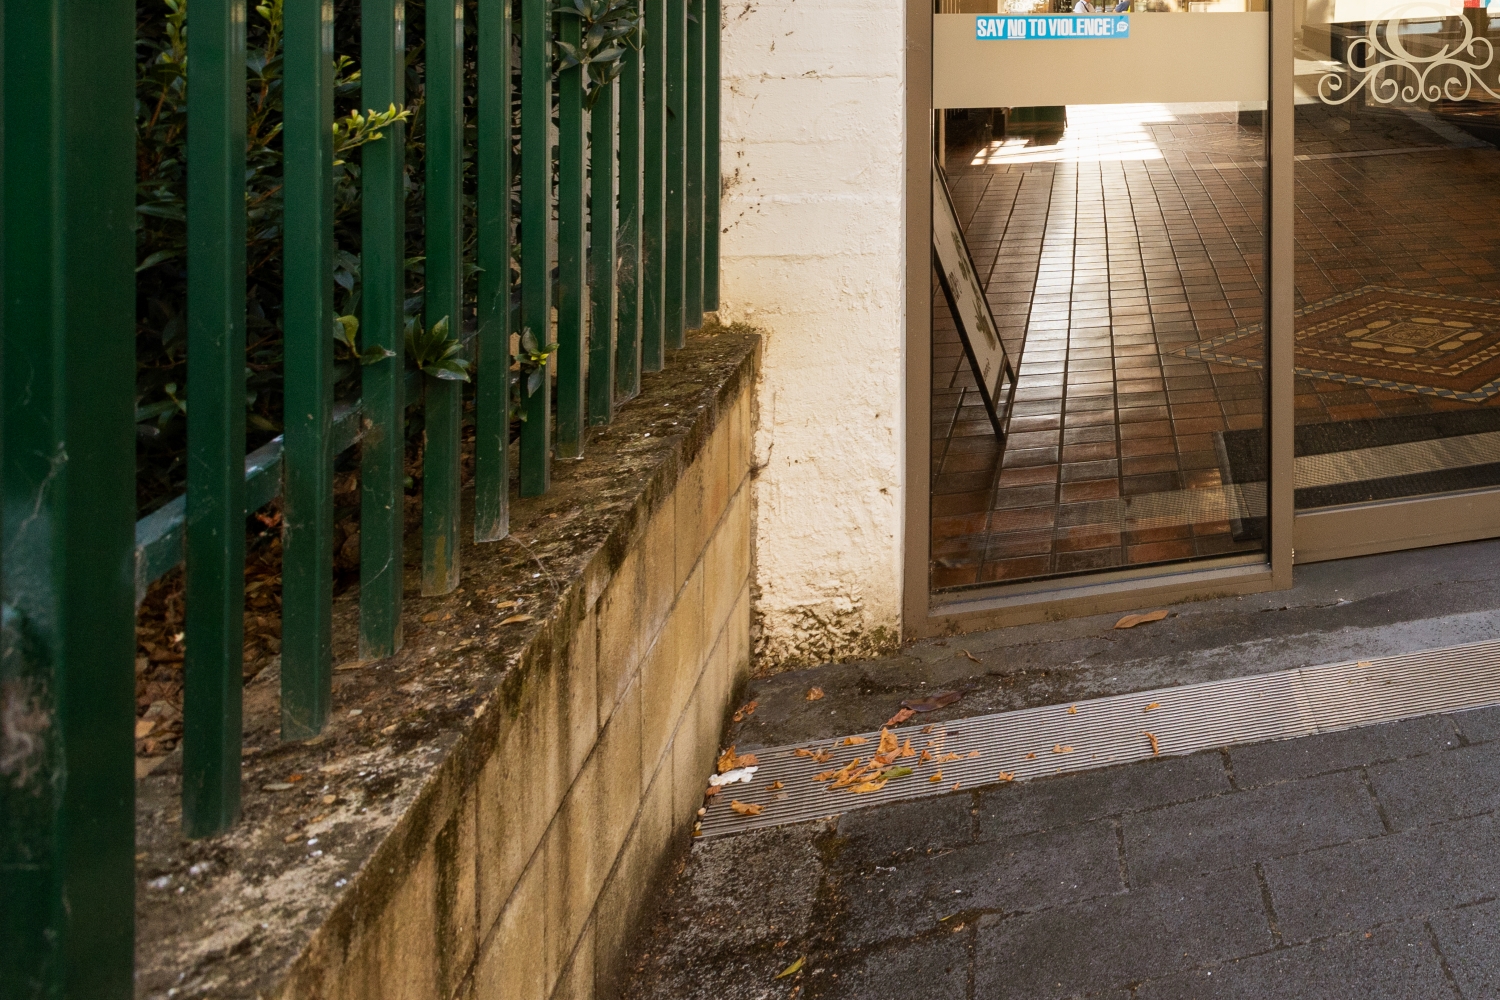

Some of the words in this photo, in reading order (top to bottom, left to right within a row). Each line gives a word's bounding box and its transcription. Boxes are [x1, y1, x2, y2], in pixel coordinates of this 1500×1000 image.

[977, 19, 1006, 37] SAY
[1007, 19, 1026, 38] NO
[1028, 19, 1046, 36] TO
[1048, 18, 1111, 36] VIOLENCE
